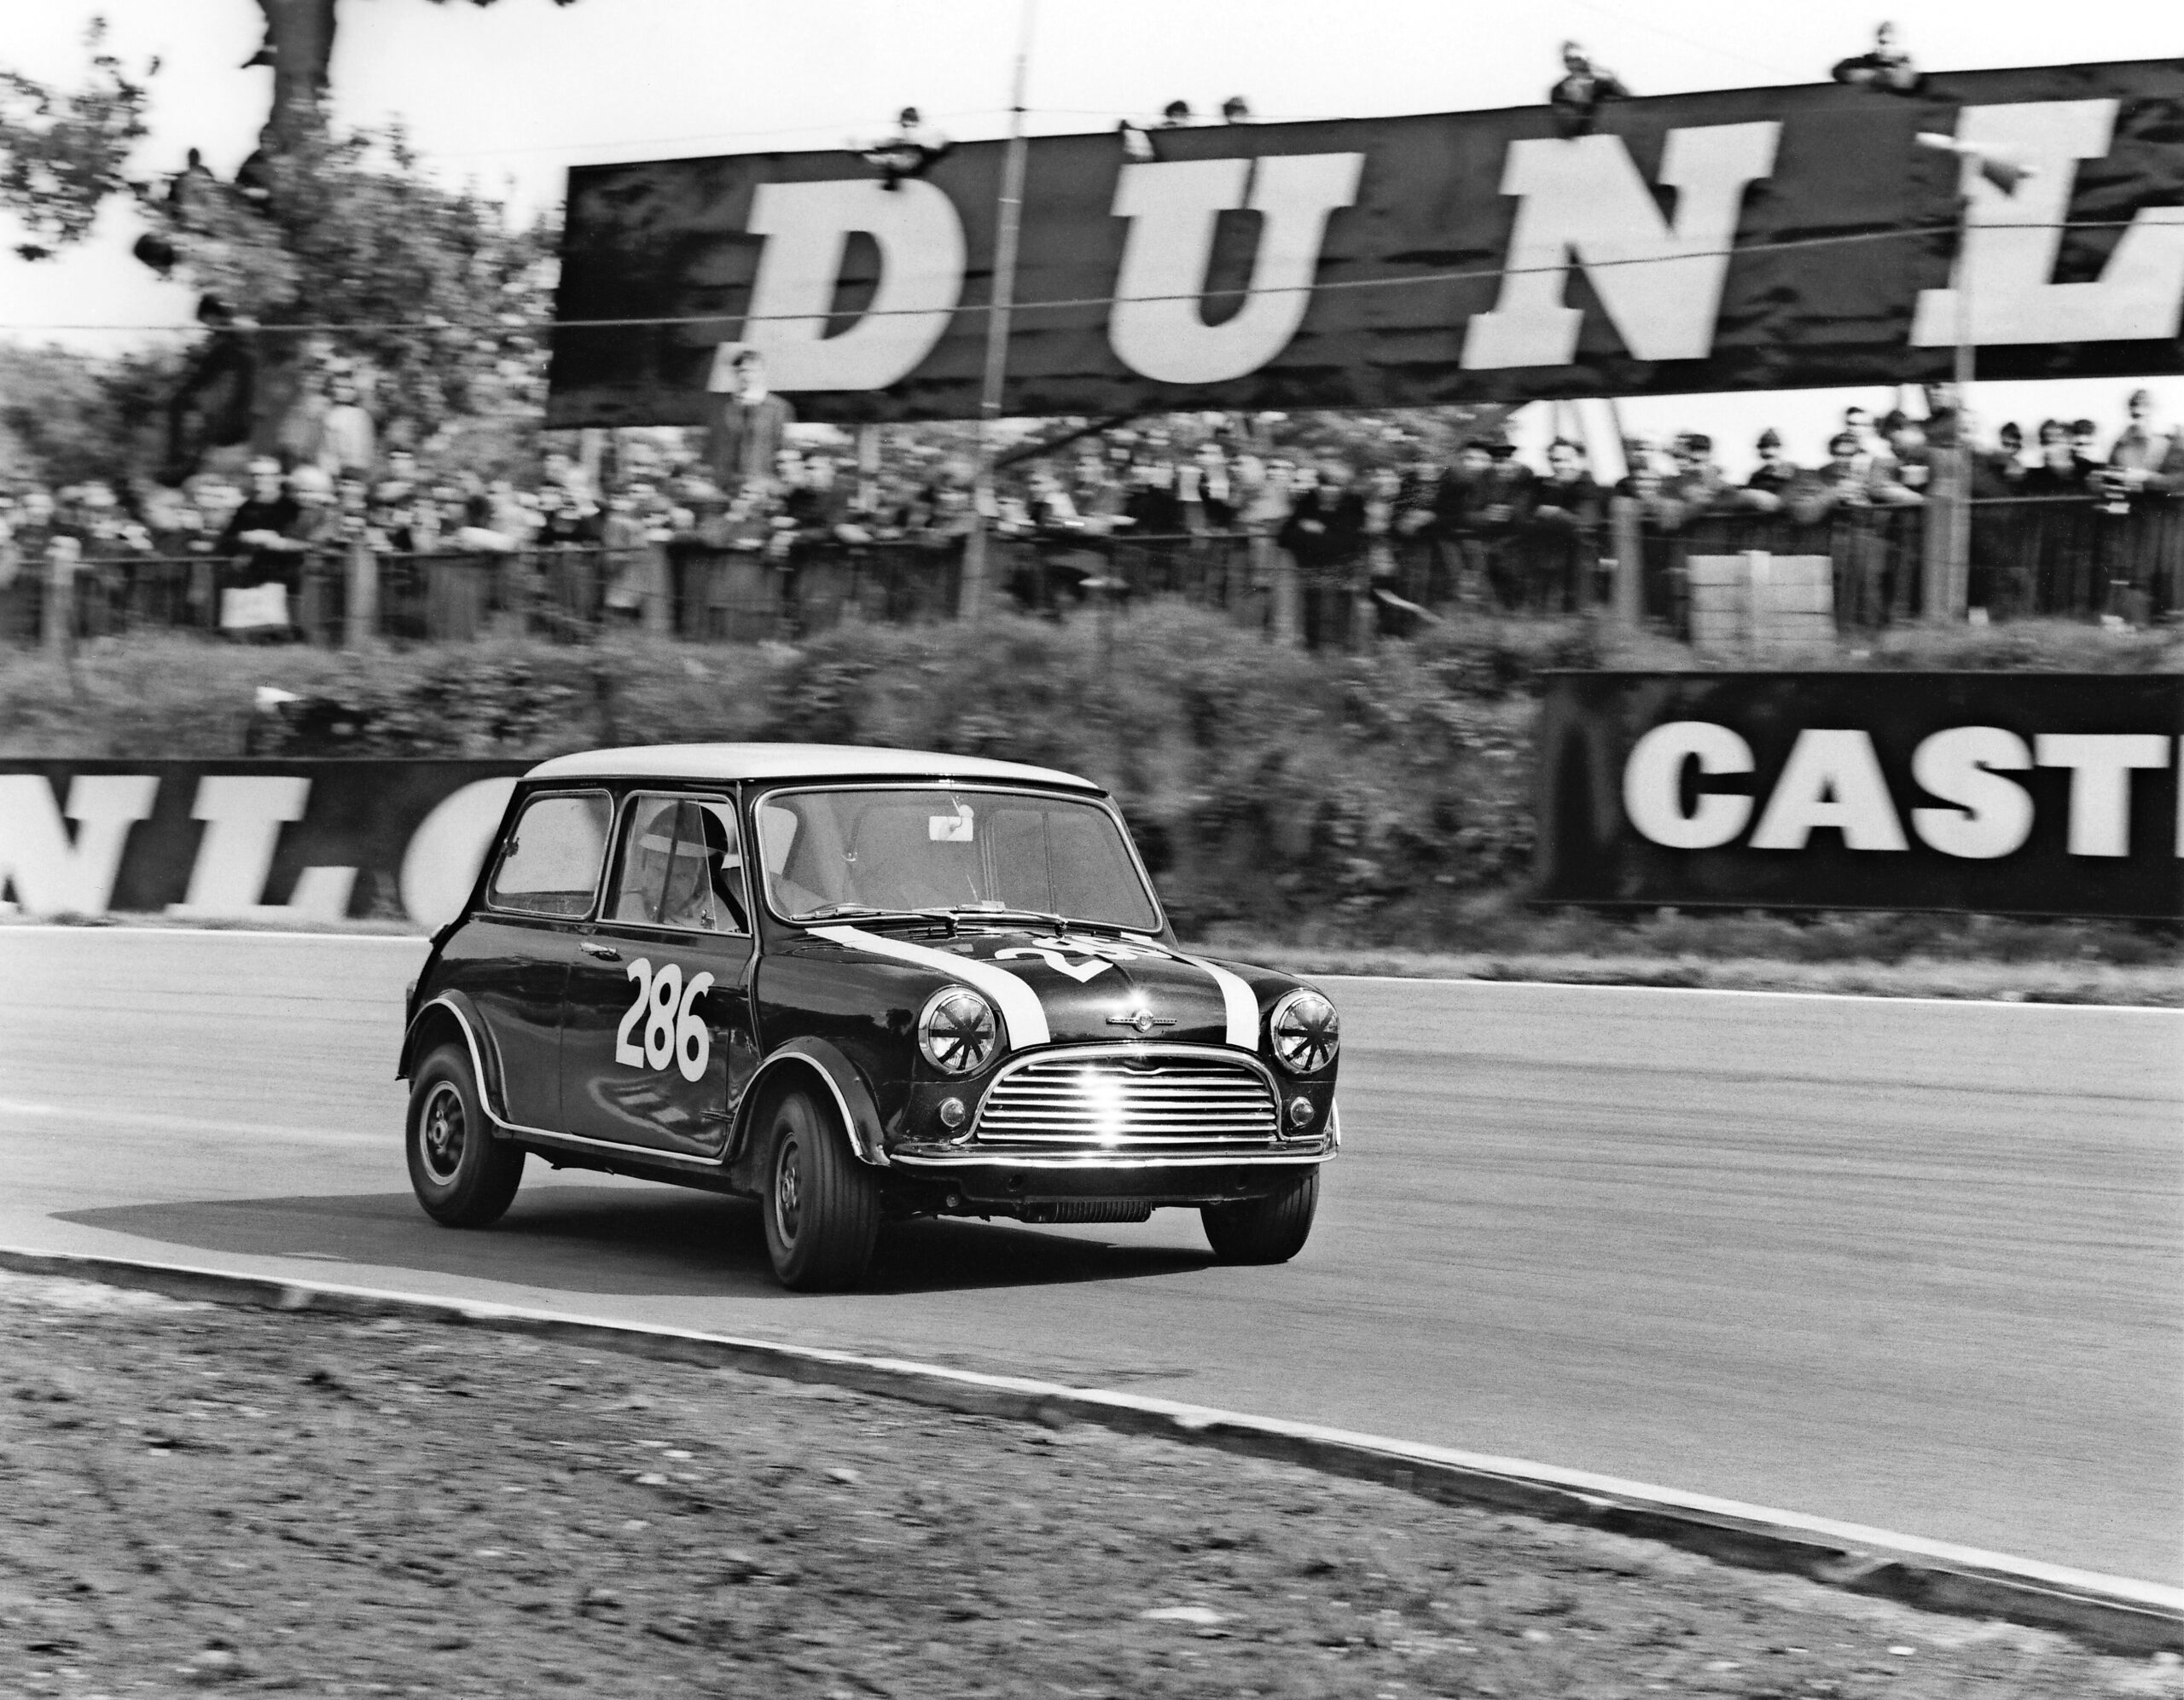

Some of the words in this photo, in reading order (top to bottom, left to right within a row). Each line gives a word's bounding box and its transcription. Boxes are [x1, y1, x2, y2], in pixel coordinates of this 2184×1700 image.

[708, 99, 2184, 392] DUNL
[1623, 721, 2184, 859] CAST
[616, 958, 715, 1082] 286
